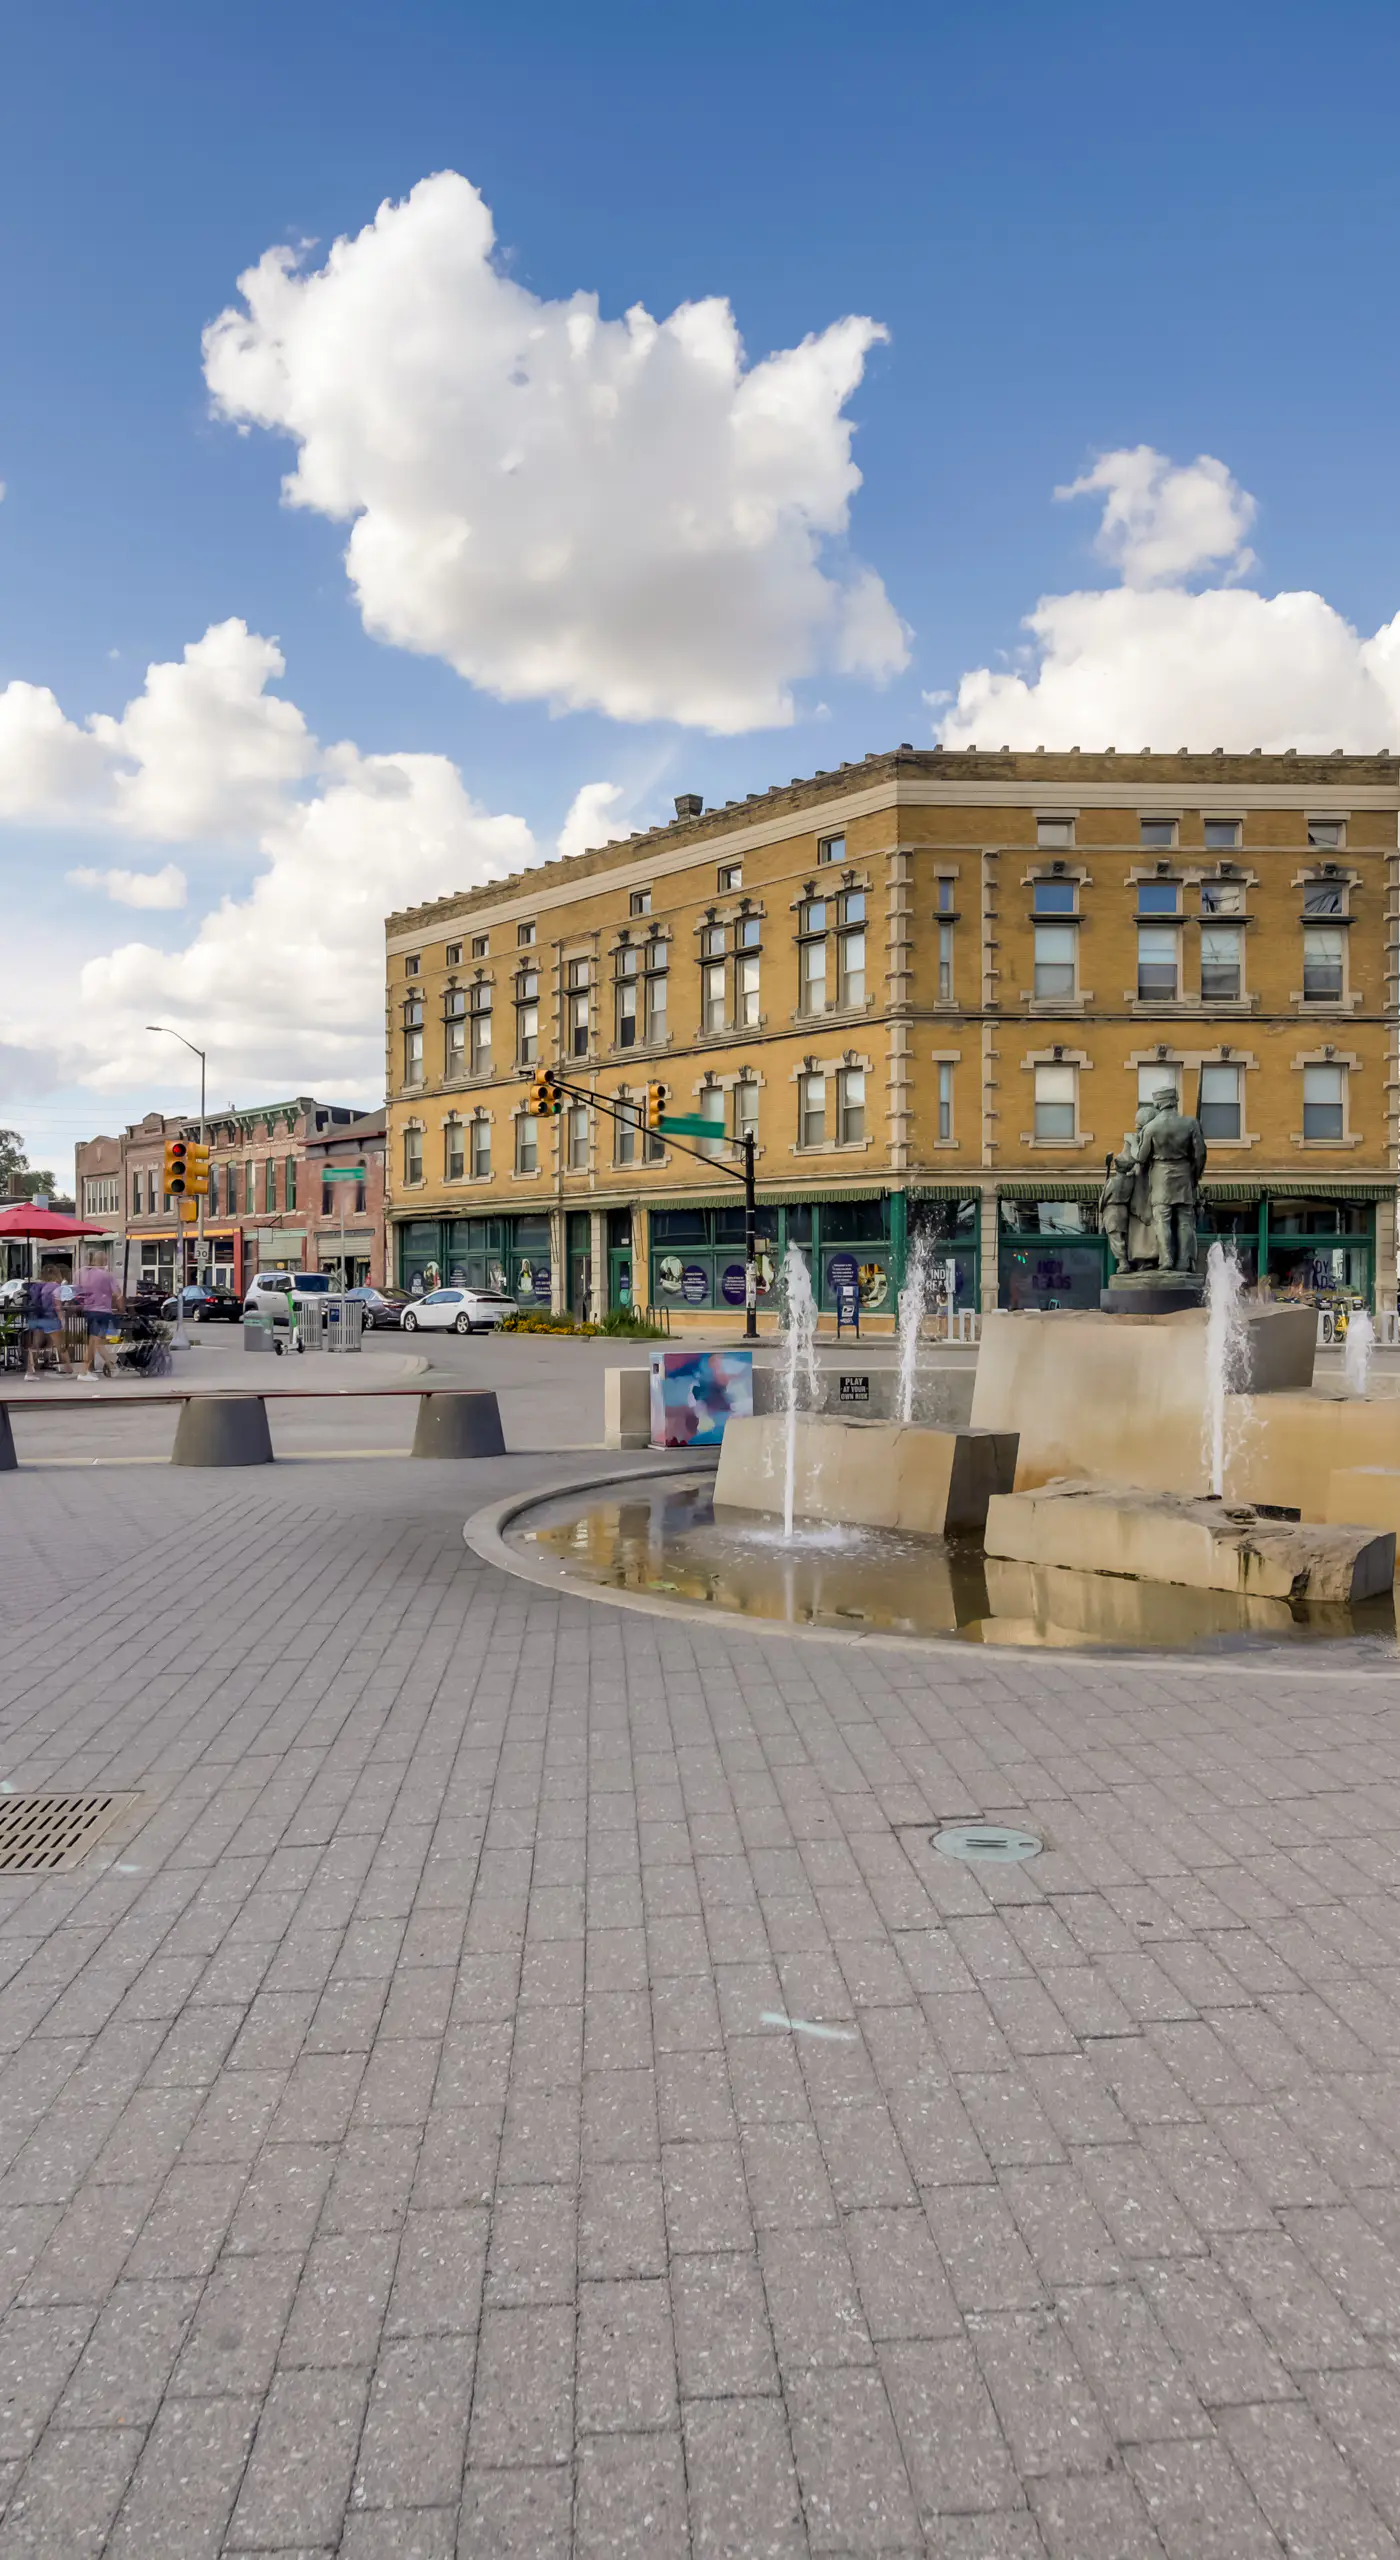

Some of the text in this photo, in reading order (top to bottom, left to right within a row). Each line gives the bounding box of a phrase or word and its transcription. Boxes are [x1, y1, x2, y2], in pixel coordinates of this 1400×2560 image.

[196, 1250, 208, 1258] 30
[931, 1268, 946, 1280] IND
[1032, 1275, 1071, 1290] READS
[845, 1377, 863, 1385] PLAY
